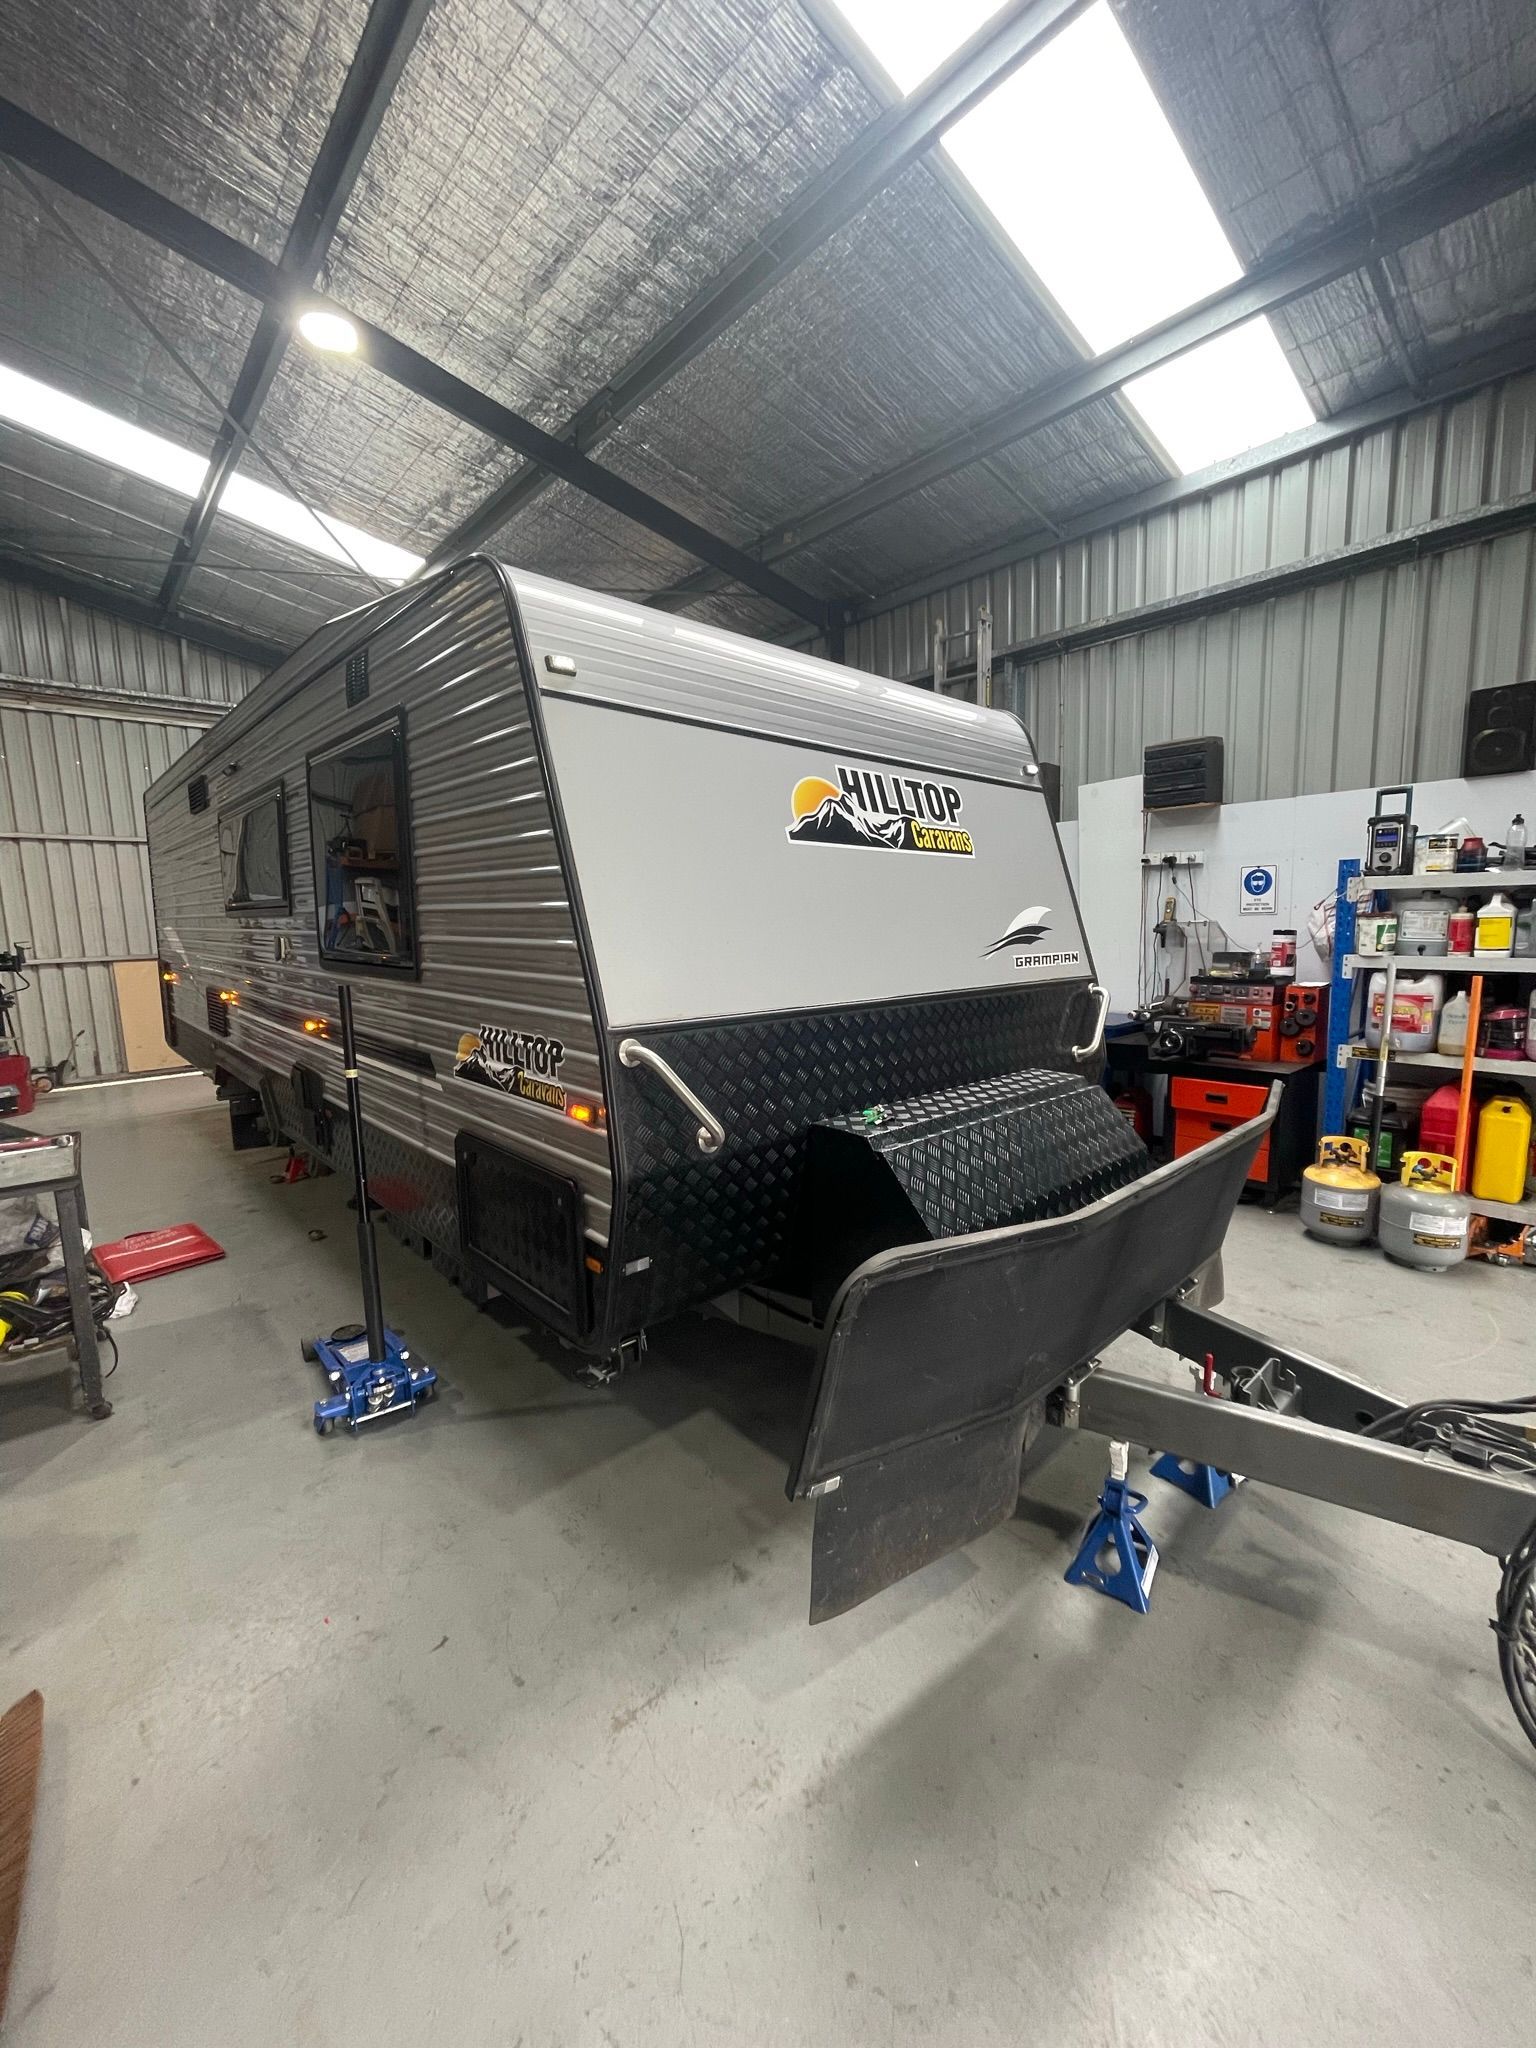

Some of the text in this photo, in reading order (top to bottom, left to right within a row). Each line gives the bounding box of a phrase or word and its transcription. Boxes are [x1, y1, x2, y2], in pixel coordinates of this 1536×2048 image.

[837, 766, 962, 823] HILLTOP
[911, 821, 973, 853] Caravans
[1015, 953, 1080, 968] GRAMPIAN
[480, 1025, 565, 1077] HILLTOP
[517, 1071, 564, 1106] Caravans
